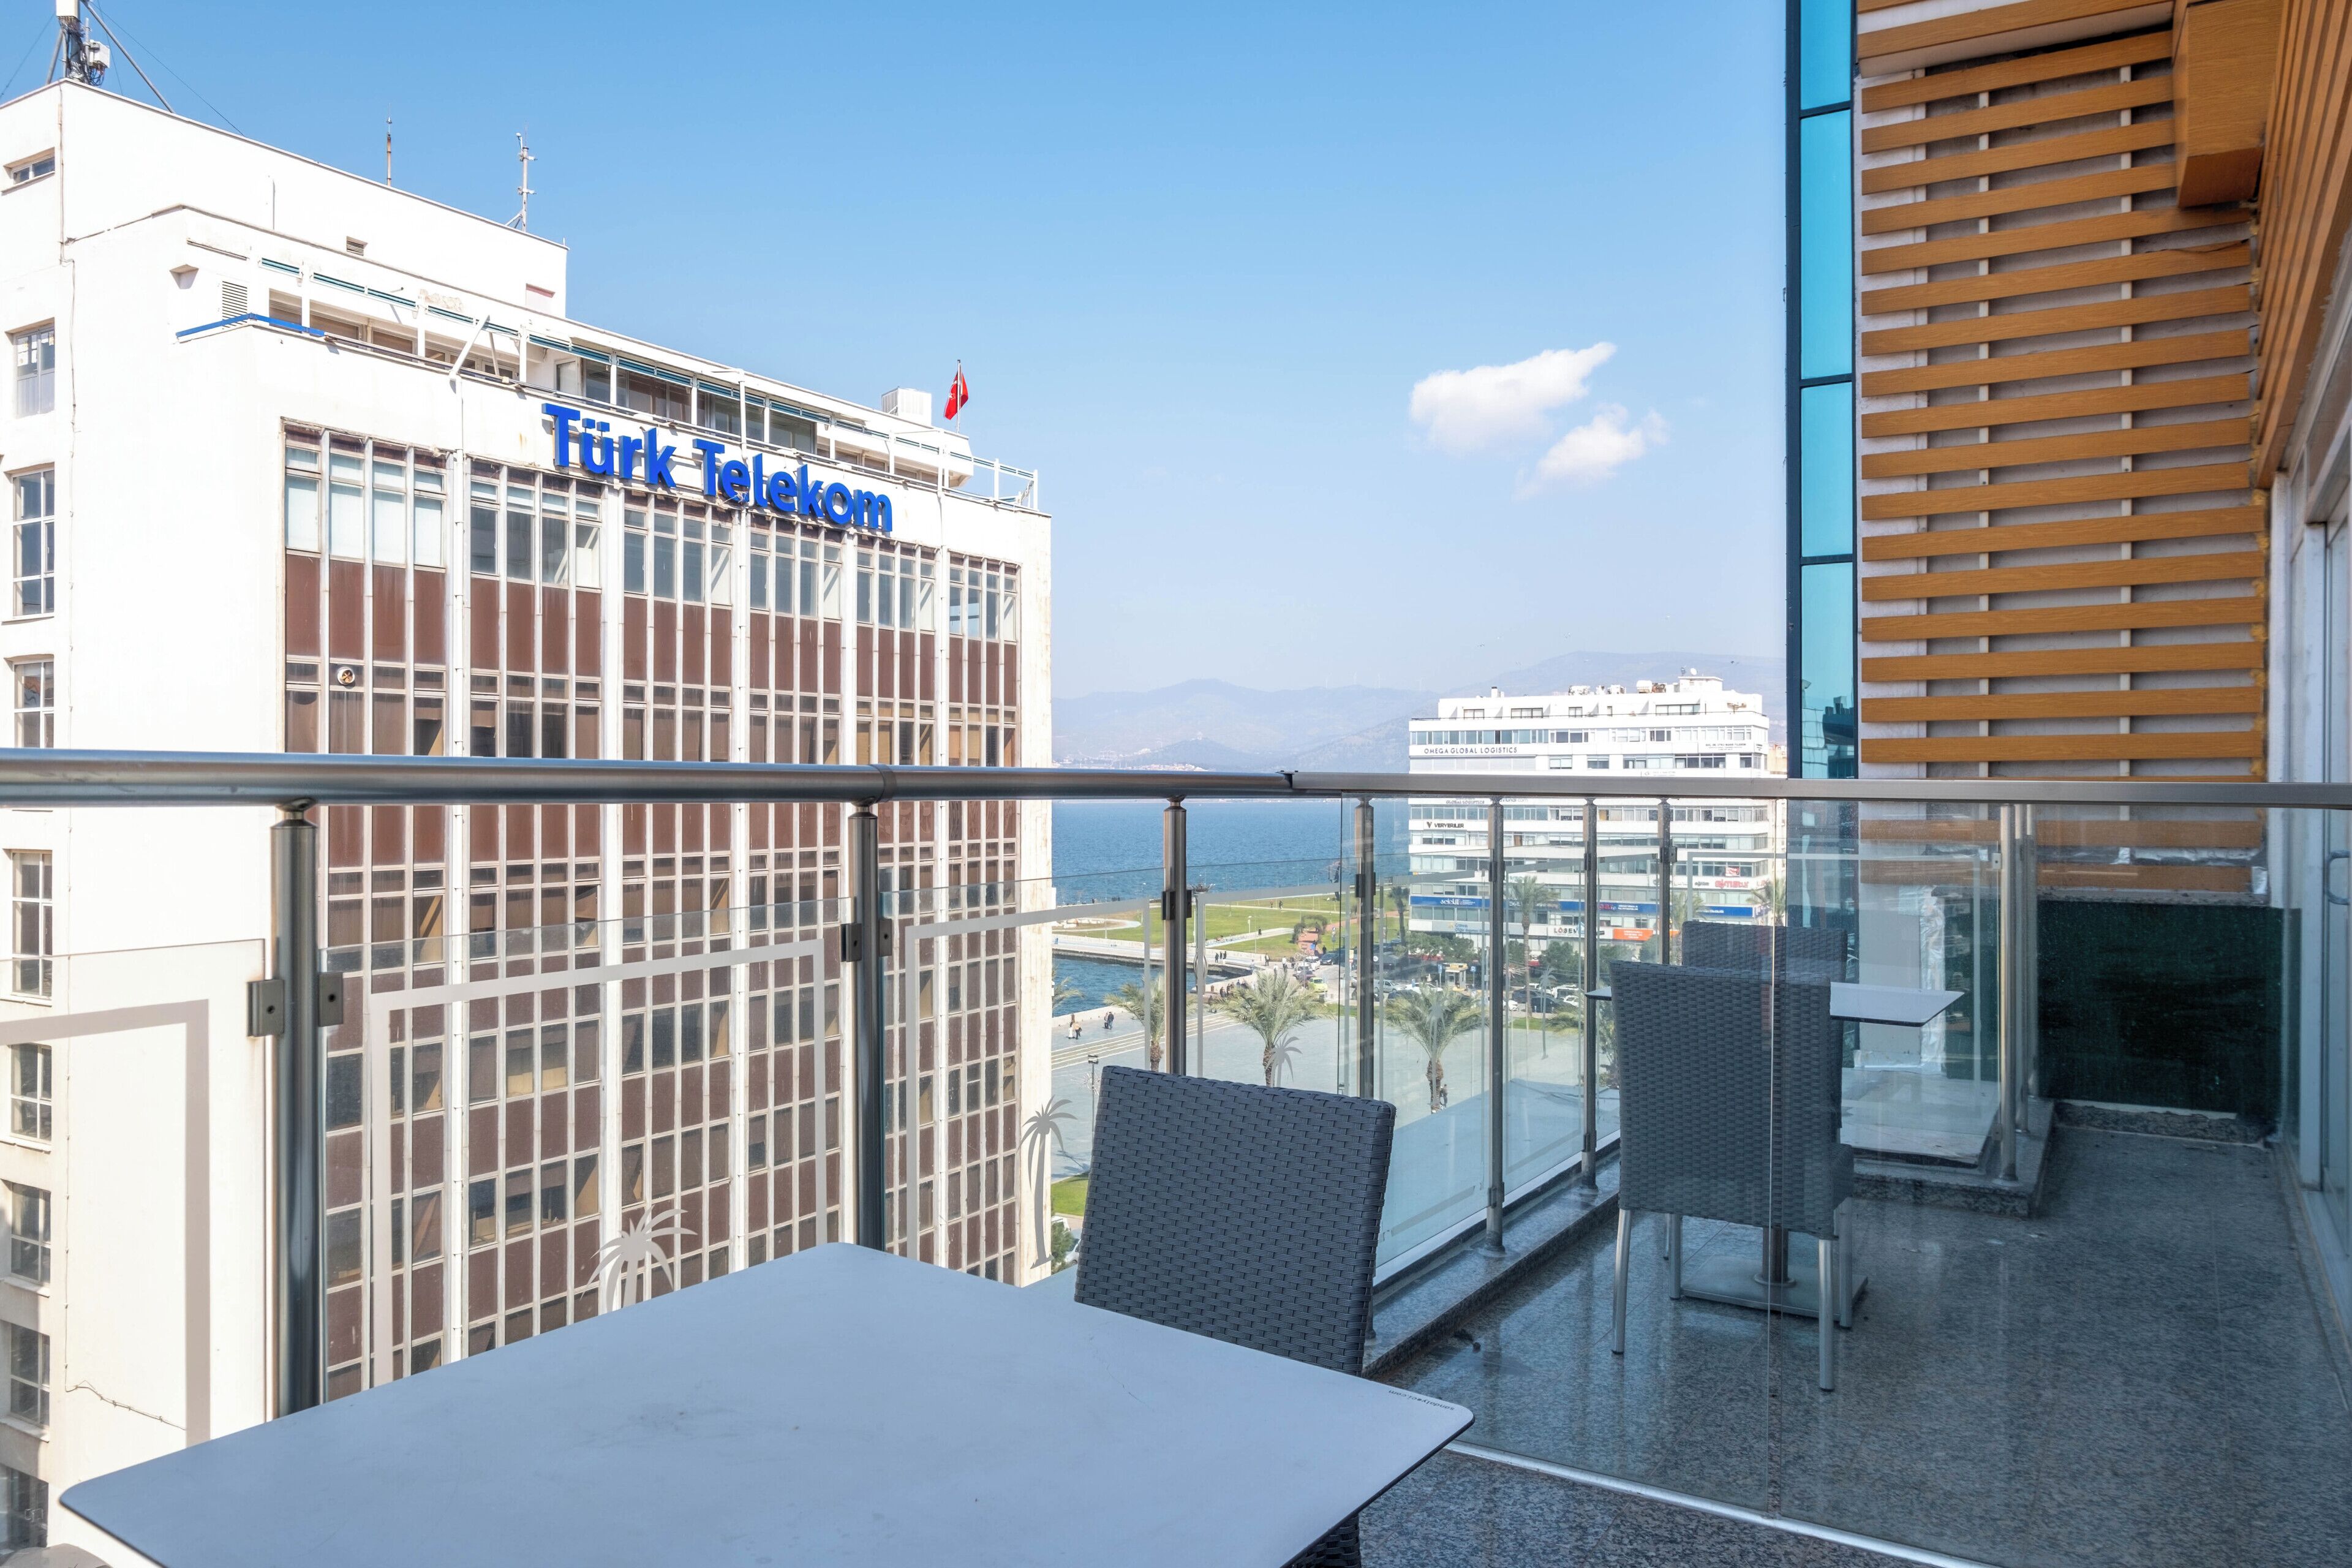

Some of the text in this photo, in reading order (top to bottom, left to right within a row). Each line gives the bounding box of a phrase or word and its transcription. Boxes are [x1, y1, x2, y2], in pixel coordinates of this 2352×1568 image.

[541, 403, 892, 532] Türk Telekom
[1388, 1390, 1455, 1411] sandalyeci.com
